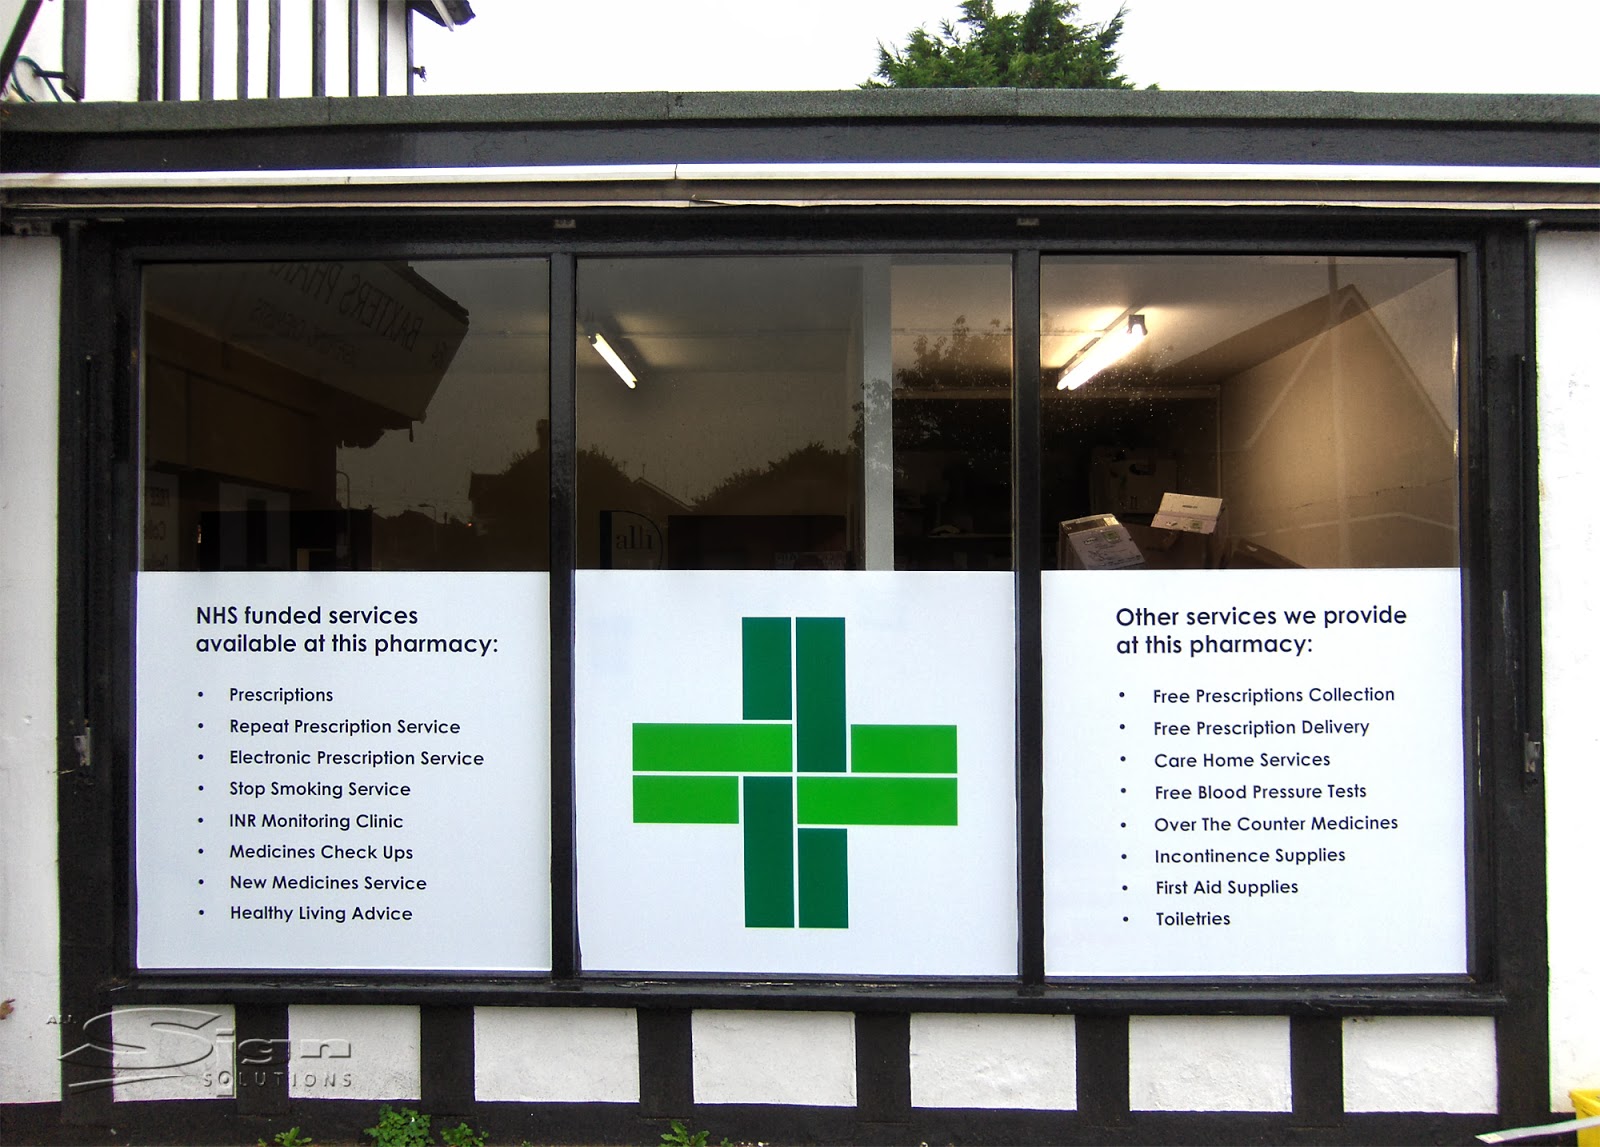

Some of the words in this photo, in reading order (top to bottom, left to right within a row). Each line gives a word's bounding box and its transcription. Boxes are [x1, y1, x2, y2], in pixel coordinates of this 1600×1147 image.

[196, 605, 238, 625] NHS
[244, 605, 321, 625] funded
[328, 605, 418, 625] services
[1116, 607, 1179, 627] Other
[1186, 606, 1277, 626] services
[1283, 610, 1317, 625] we
[1324, 604, 1407, 629] provide
[195, 633, 297, 653] available
[303, 634, 326, 653] at
[331, 633, 367, 653] this
[375, 633, 498, 657] pharmacy:
[1116, 635, 1139, 655] at
[1145, 634, 1182, 654] this
[1190, 634, 1312, 658] pharmacy:
[229, 687, 334, 705] Prescriptions
[1153, 689, 1190, 704] Free
[1196, 687, 1303, 706] Prescriptions
[1308, 686, 1395, 702] Collection
[230, 719, 290, 737] Repeat
[294, 718, 392, 737] Prescription
[397, 719, 461, 734] Service
[1154, 721, 1191, 736] Free
[1197, 720, 1296, 739] Prescription
[1302, 719, 1370, 737] Delivery
[230, 749, 311, 765] Electronic
[317, 750, 415, 768] Prescription
[420, 750, 485, 766] Service
[1154, 753, 1197, 768] Care
[1203, 753, 1255, 768] Home
[1260, 752, 1331, 767] Services
[229, 781, 266, 799] Stop
[270, 781, 343, 800] Smoking
[348, 781, 411, 797] Service
[1155, 785, 1192, 800] Free
[1198, 784, 1247, 800] Blood
[1253, 785, 1323, 799] Pressure
[1327, 783, 1367, 798] Tests
[229, 813, 256, 828] INR
[261, 813, 350, 832] Monitoring
[355, 813, 404, 829] Clinic
[1154, 817, 1197, 832] Over
[1201, 817, 1232, 832] The
[1237, 816, 1306, 831] Counter
[1311, 815, 1398, 831] Medicines
[229, 844, 316, 859] Medicines
[320, 844, 378, 859] Check
[383, 845, 414, 863] Ups
[1155, 848, 1270, 864] Incontinence
[1275, 847, 1346, 866] Supplies
[230, 875, 267, 889] New
[272, 875, 359, 890] Medicines
[364, 875, 427, 891] Service
[1156, 880, 1188, 895] First
[1193, 880, 1222, 895] Aid
[1227, 879, 1299, 898] Supplies
[230, 905, 294, 923] Healthy
[299, 905, 346, 924] Living
[351, 906, 413, 921] Advice
[1155, 911, 1231, 926] Toiletries
